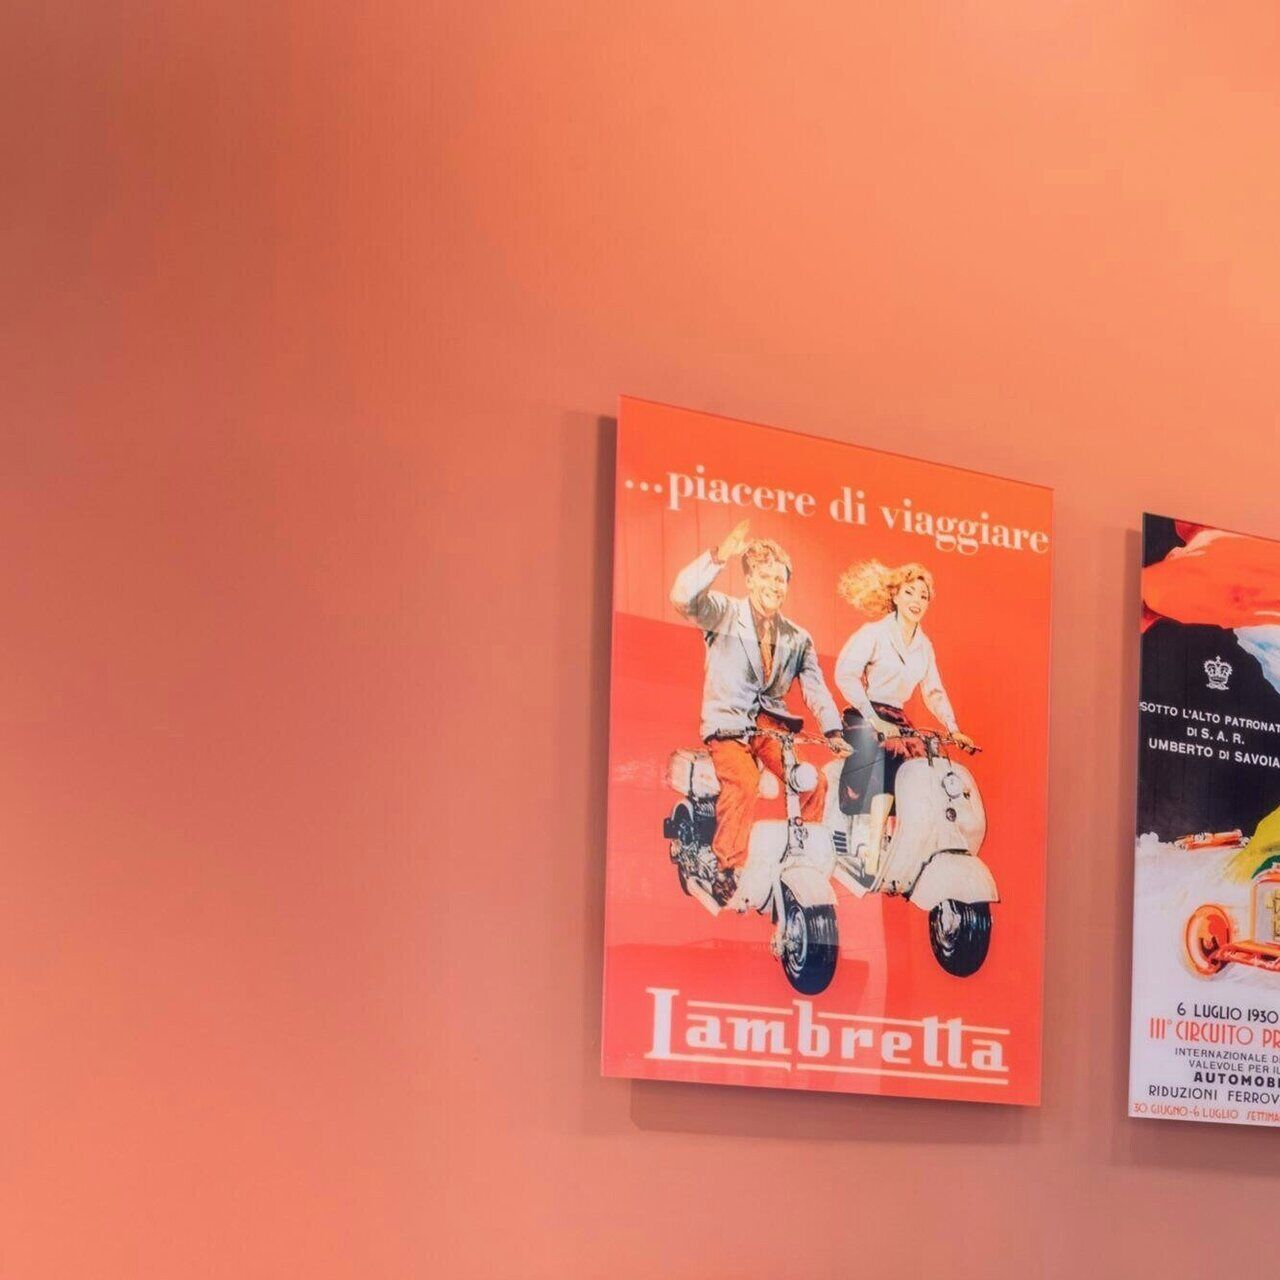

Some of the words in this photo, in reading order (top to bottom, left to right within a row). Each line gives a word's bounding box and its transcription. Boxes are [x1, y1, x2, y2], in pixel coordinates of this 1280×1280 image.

[829, 486, 867, 526] di
[879, 498, 1050, 556] viaggiare
[1139, 701, 1179, 717] SOTTO
[1183, 708, 1221, 723] L'ALTO
[1187, 727, 1198, 737] DI
[1201, 728, 1214, 740] S.
[1217, 731, 1229, 742] A.
[1233, 733, 1245, 745] R.
[1149, 738, 1214, 758] UMBERTO
[1219, 750, 1230, 761] DI
[1235, 752, 1280, 769] SAVOIA
[1177, 1002, 1187, 1017] 6
[1194, 1004, 1242, 1021] LUGLIO
[1248, 1009, 1279, 1024] 1930
[644, 986, 1011, 1074] Lambretta
[1176, 1019, 1253, 1046] CIRCUITO
[1175, 1047, 1267, 1063] INTERNAZIONALE
[1188, 1060, 1244, 1072] VALEVOLE
[1248, 1064, 1269, 1074] PER
[1149, 1084, 1218, 1101] RIDUZIONI
[1133, 1103, 1148, 1113] 30
[1203, 1108, 1239, 1120] LUGLIO
